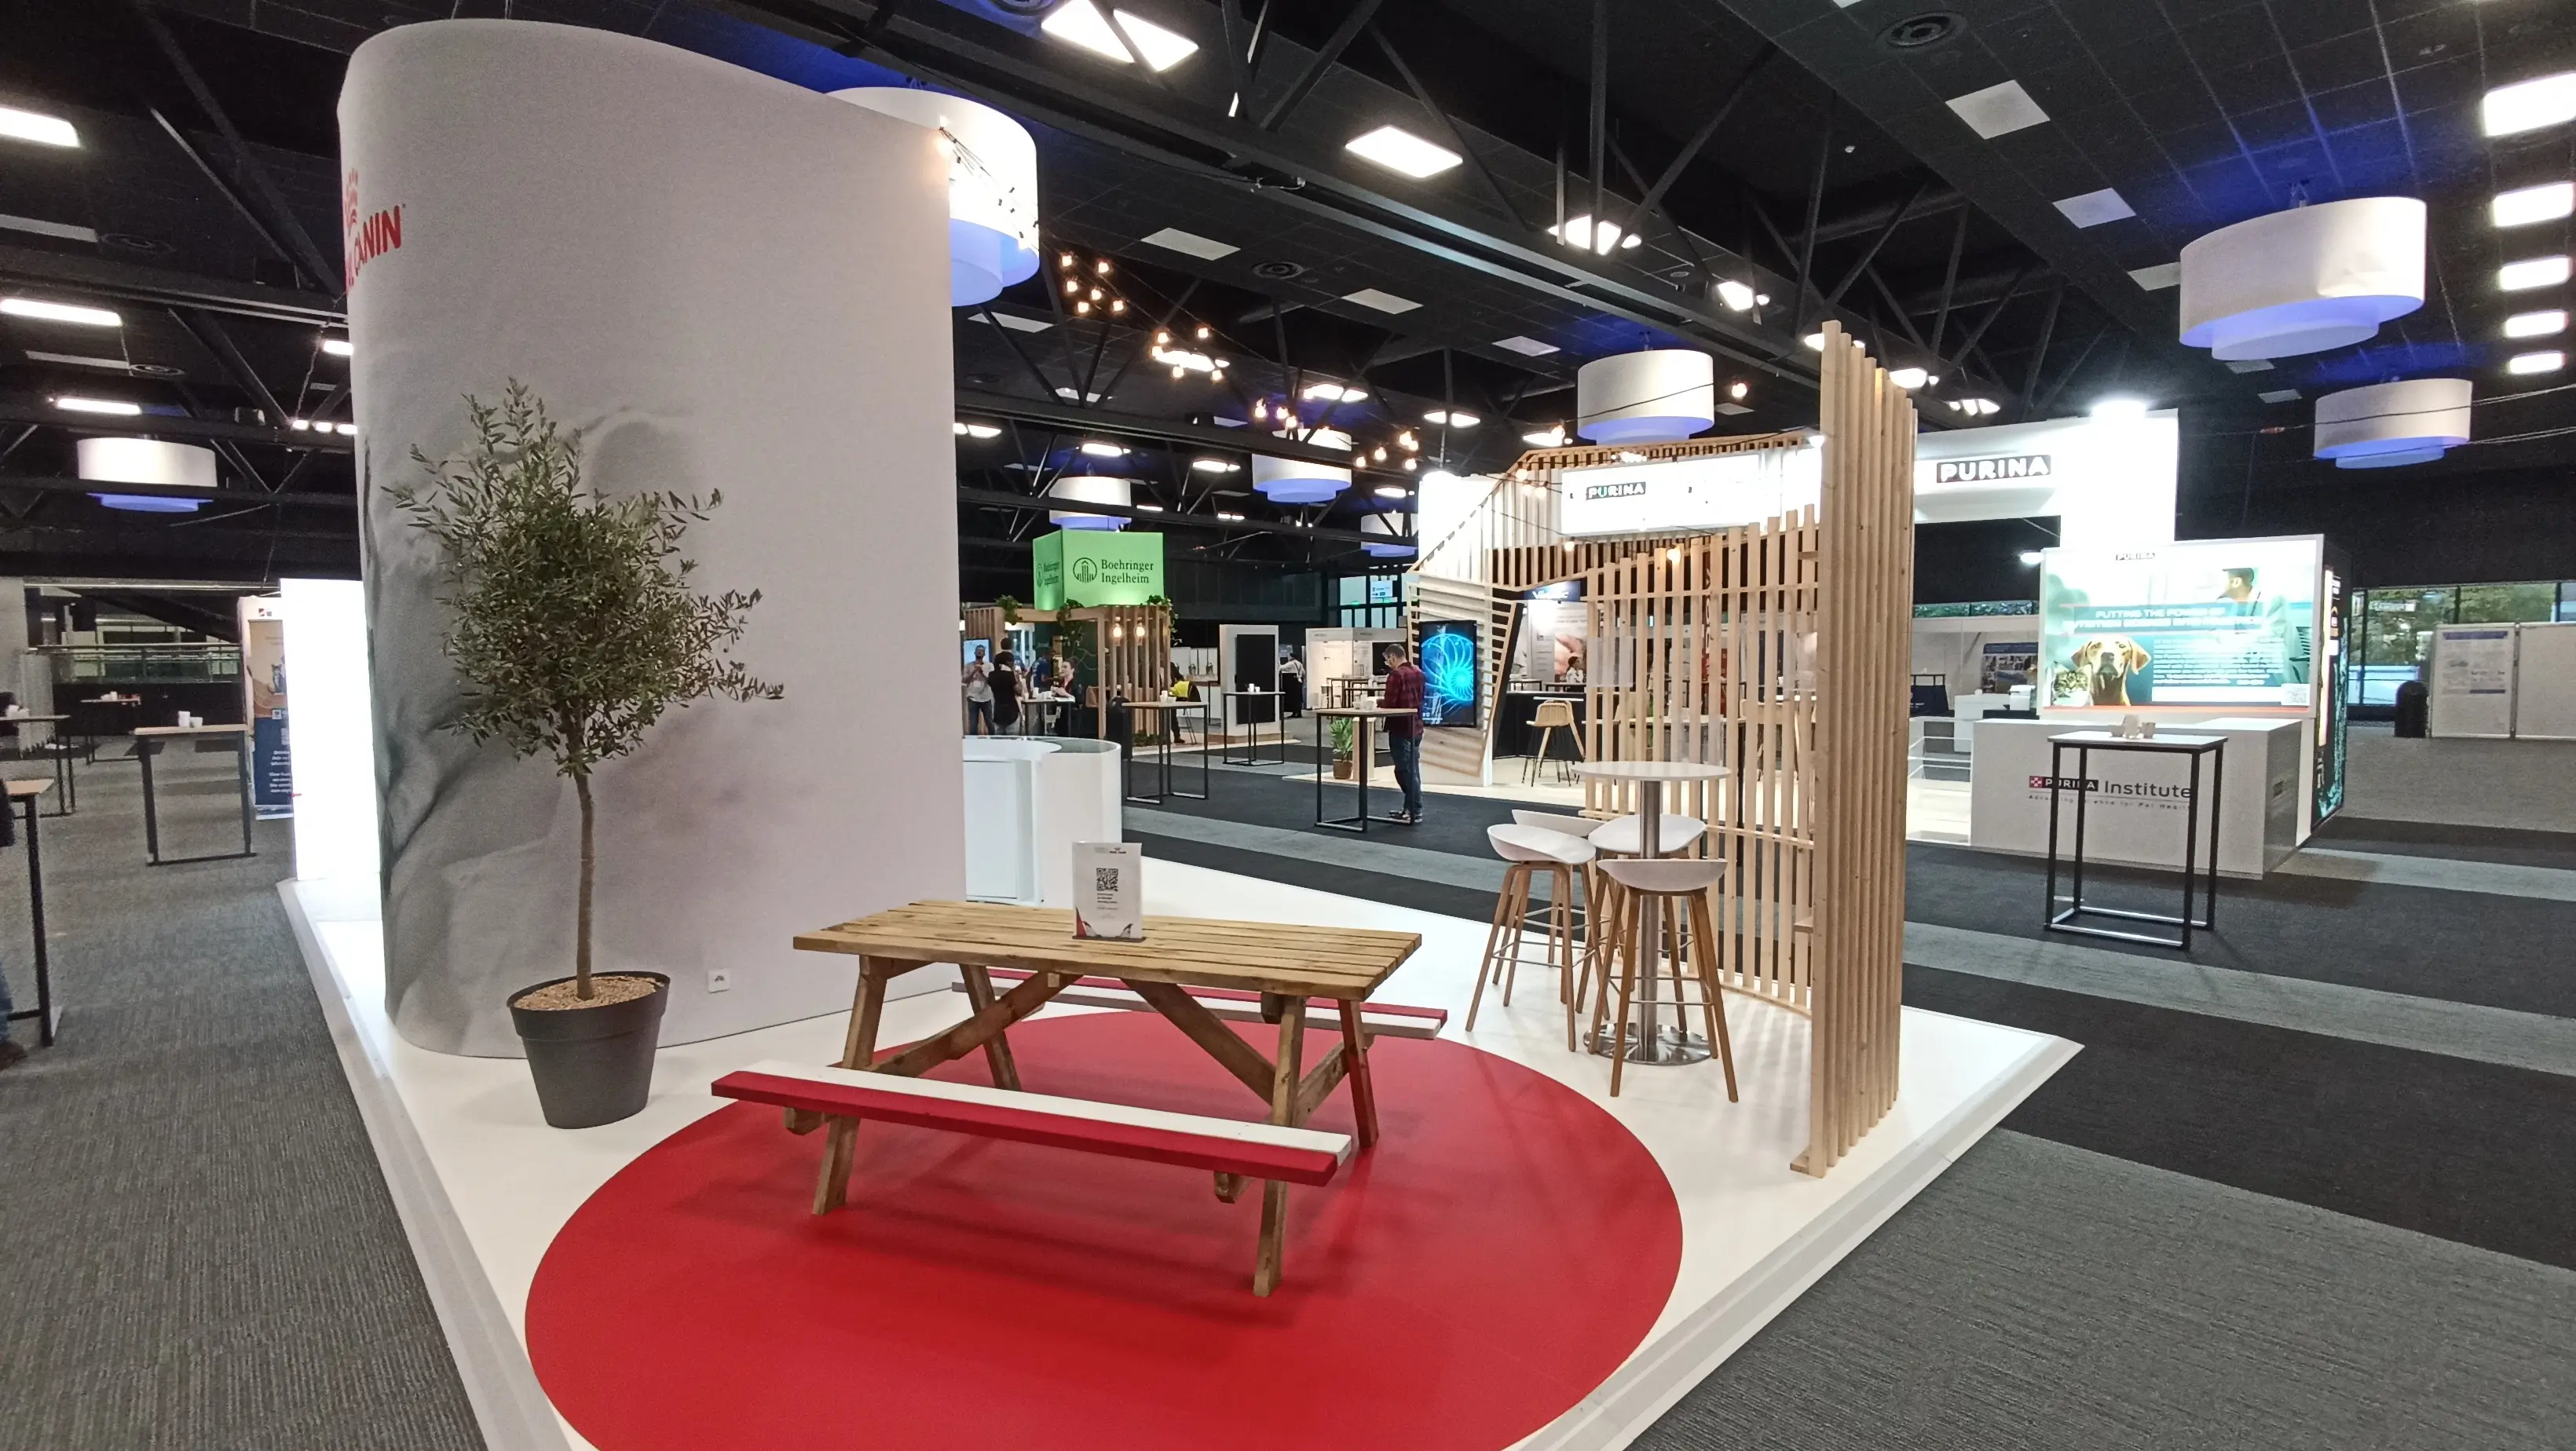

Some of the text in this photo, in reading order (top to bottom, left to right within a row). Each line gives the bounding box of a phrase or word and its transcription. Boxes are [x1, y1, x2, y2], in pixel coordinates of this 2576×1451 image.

[1941, 456, 2049, 482] PURINA
[1587, 482, 1645, 499] PURINA
[1101, 559, 1154, 572] Boehringer
[1101, 572, 1150, 585] Ingelheim
[2105, 780, 2192, 799] Institute
